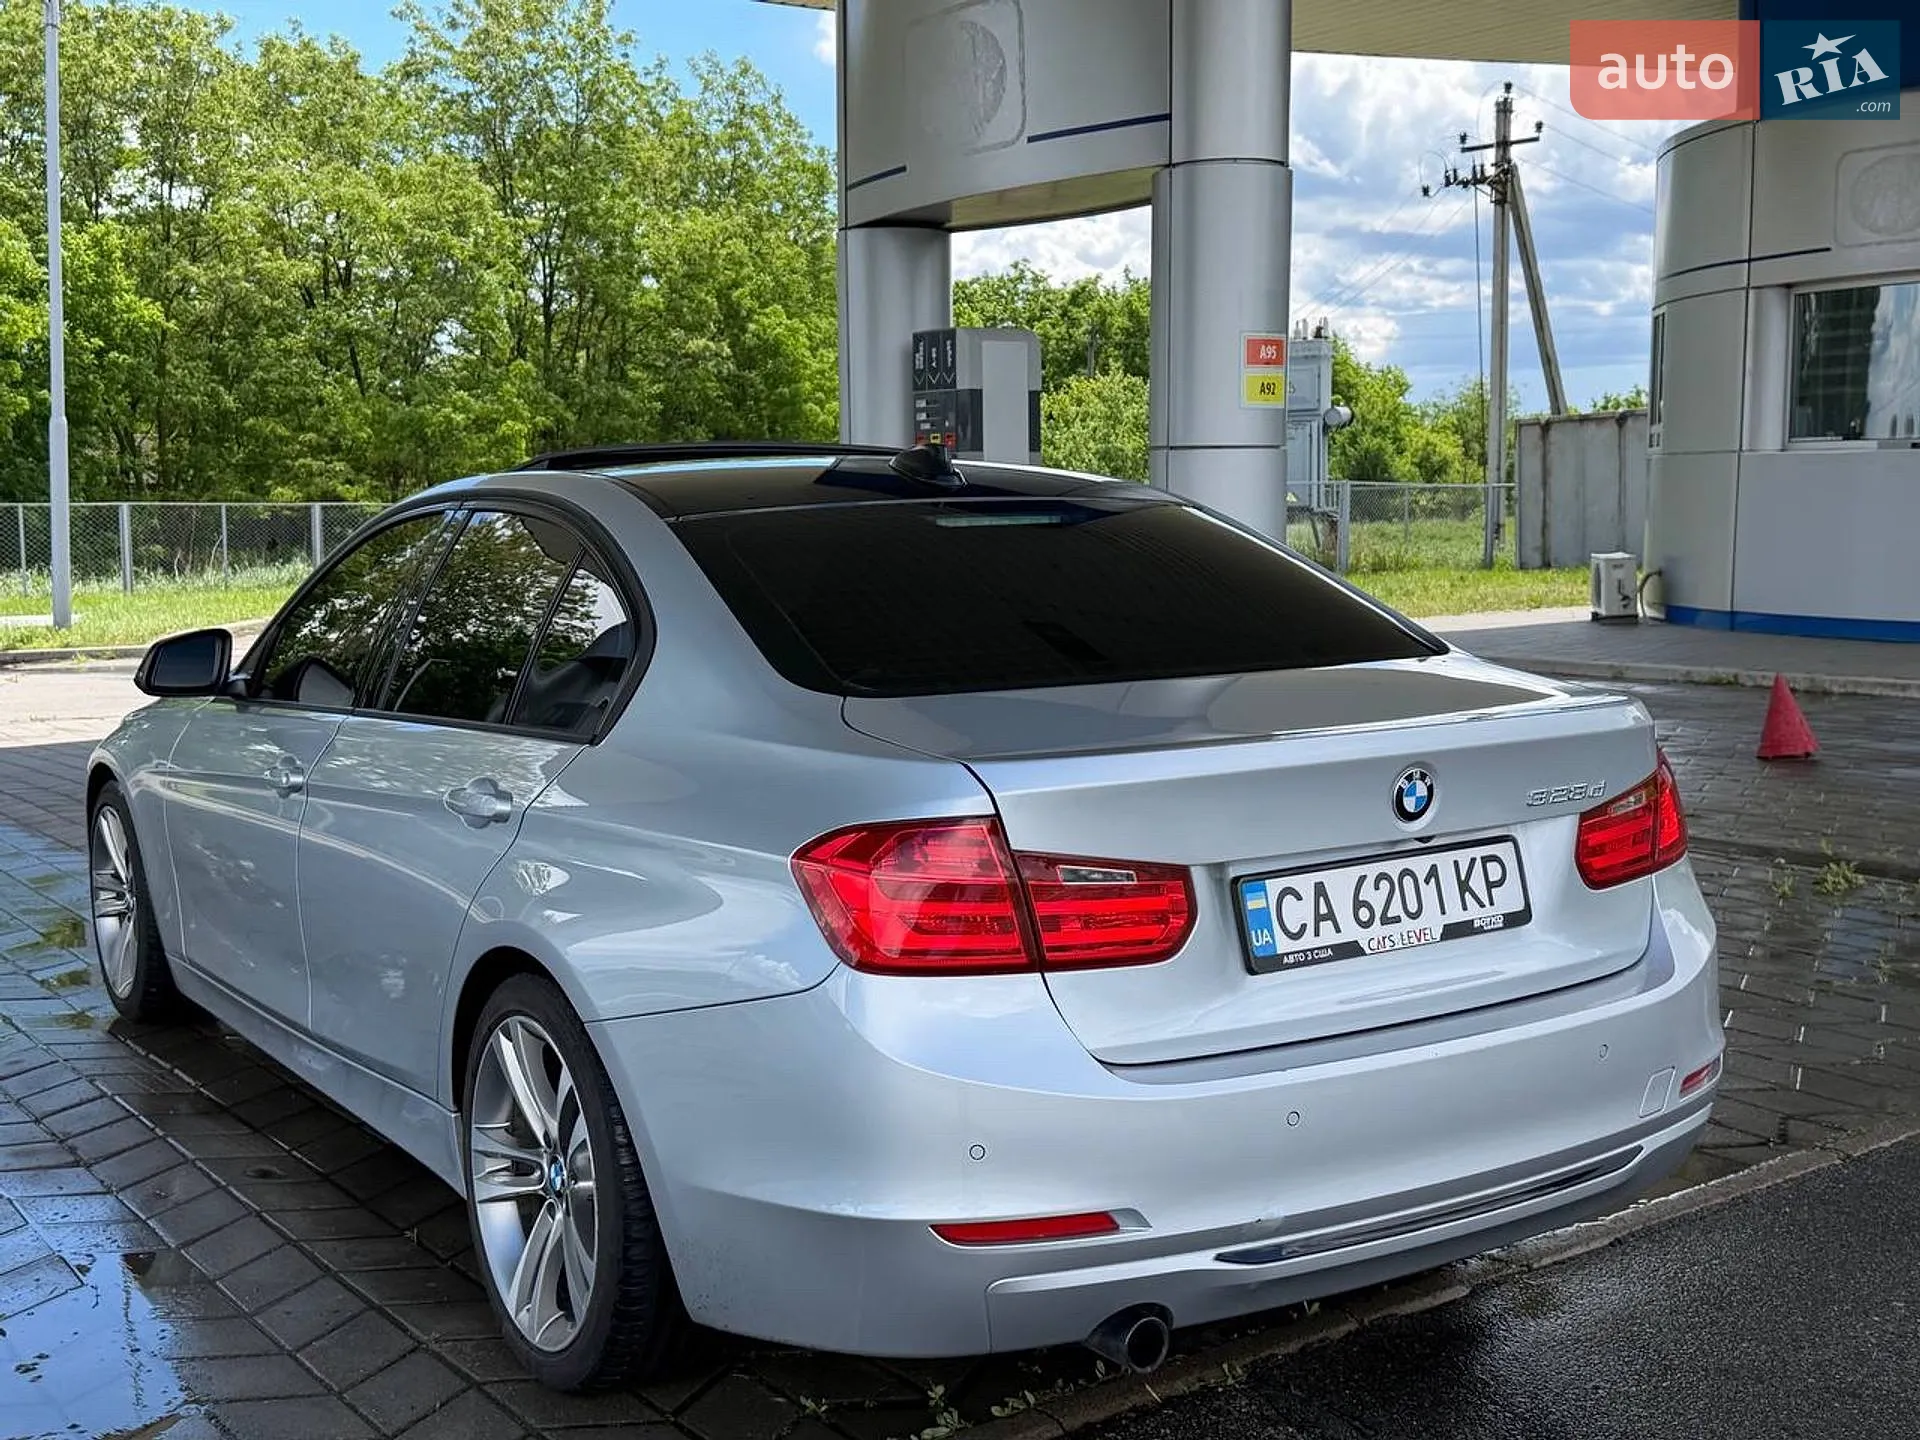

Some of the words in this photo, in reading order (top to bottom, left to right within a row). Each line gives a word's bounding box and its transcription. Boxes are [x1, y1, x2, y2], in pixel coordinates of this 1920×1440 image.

[1259, 345, 1277, 360] A95
[1259, 382, 1277, 396] A92
[1275, 880, 1341, 941] CA
[1352, 863, 1446, 930] 6201
[1453, 854, 1507, 912] KP
[1252, 928, 1272, 947] UA
[1401, 927, 1438, 946] LEVEL
